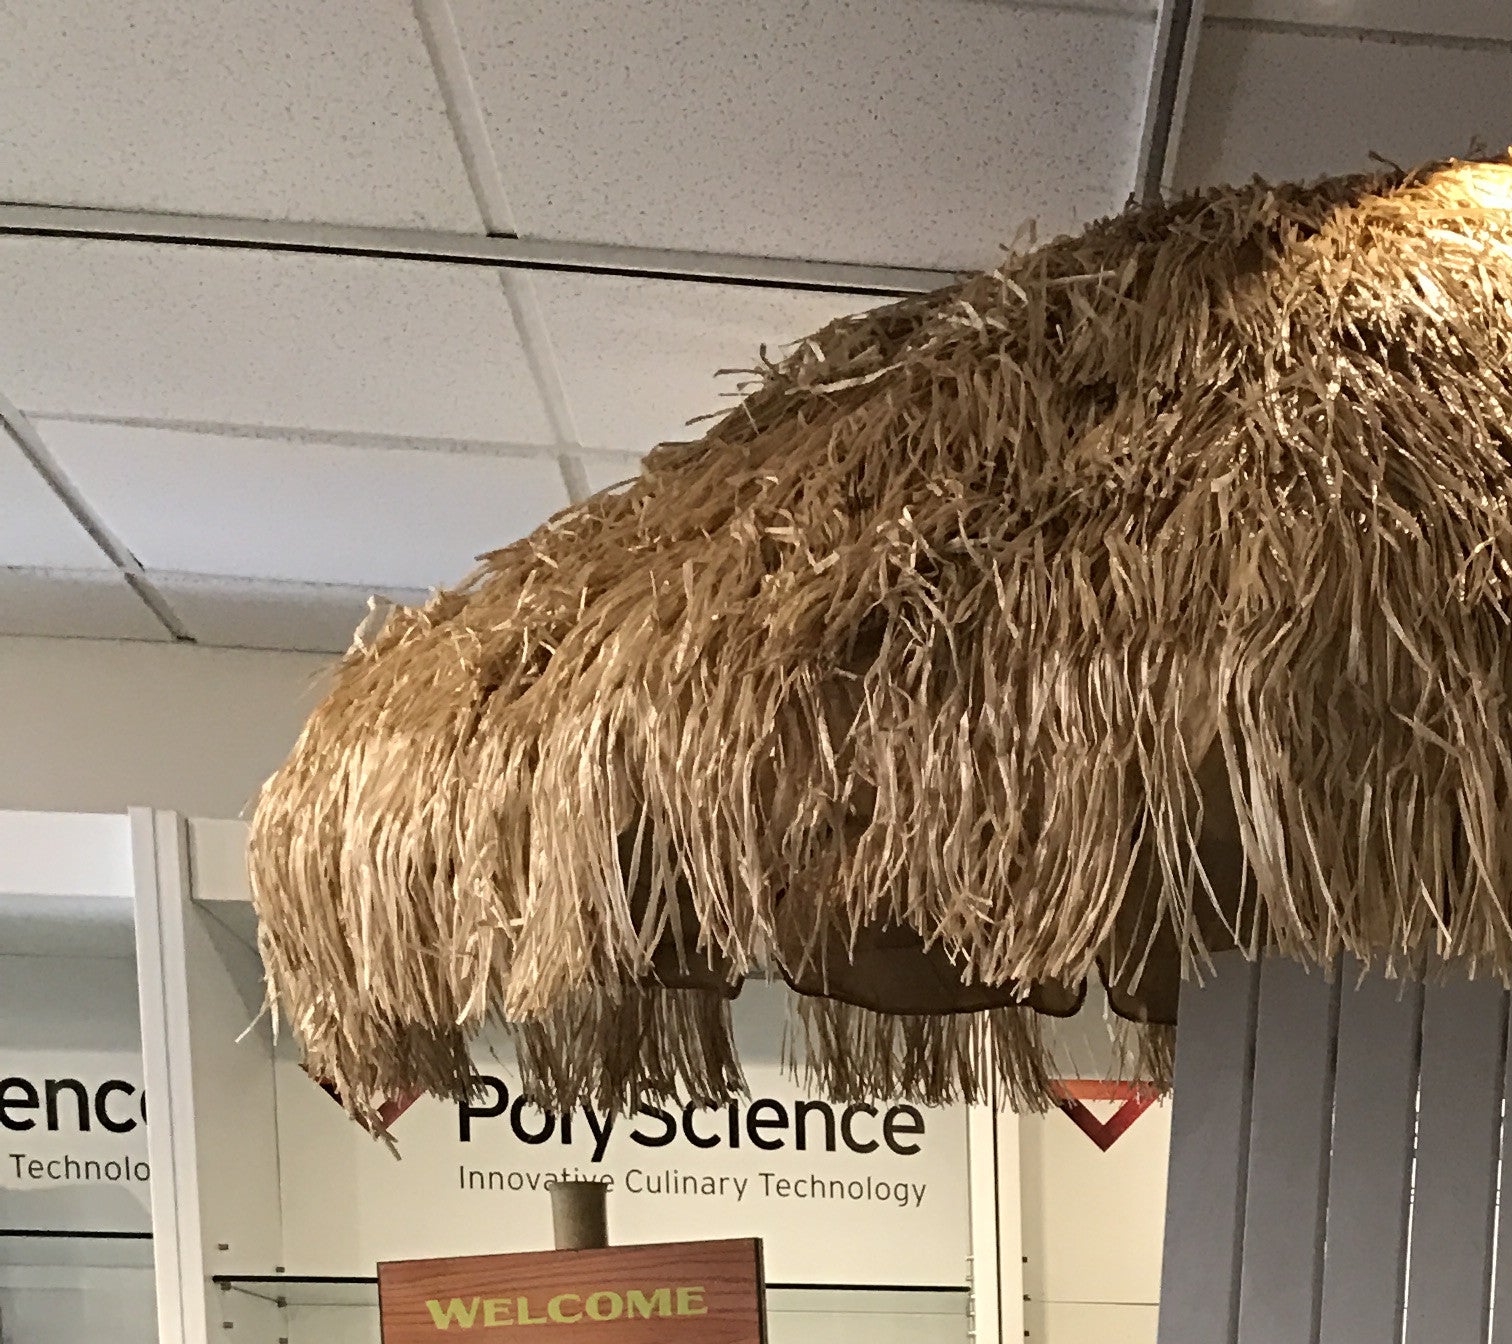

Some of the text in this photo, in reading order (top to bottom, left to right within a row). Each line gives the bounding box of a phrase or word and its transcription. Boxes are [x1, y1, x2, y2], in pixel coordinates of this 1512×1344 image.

[0, 1076, 149, 1133] enc
[625, 1168, 748, 1201] Culinary
[758, 1172, 927, 1208] Technology
[425, 1285, 709, 1331] WELCOME
